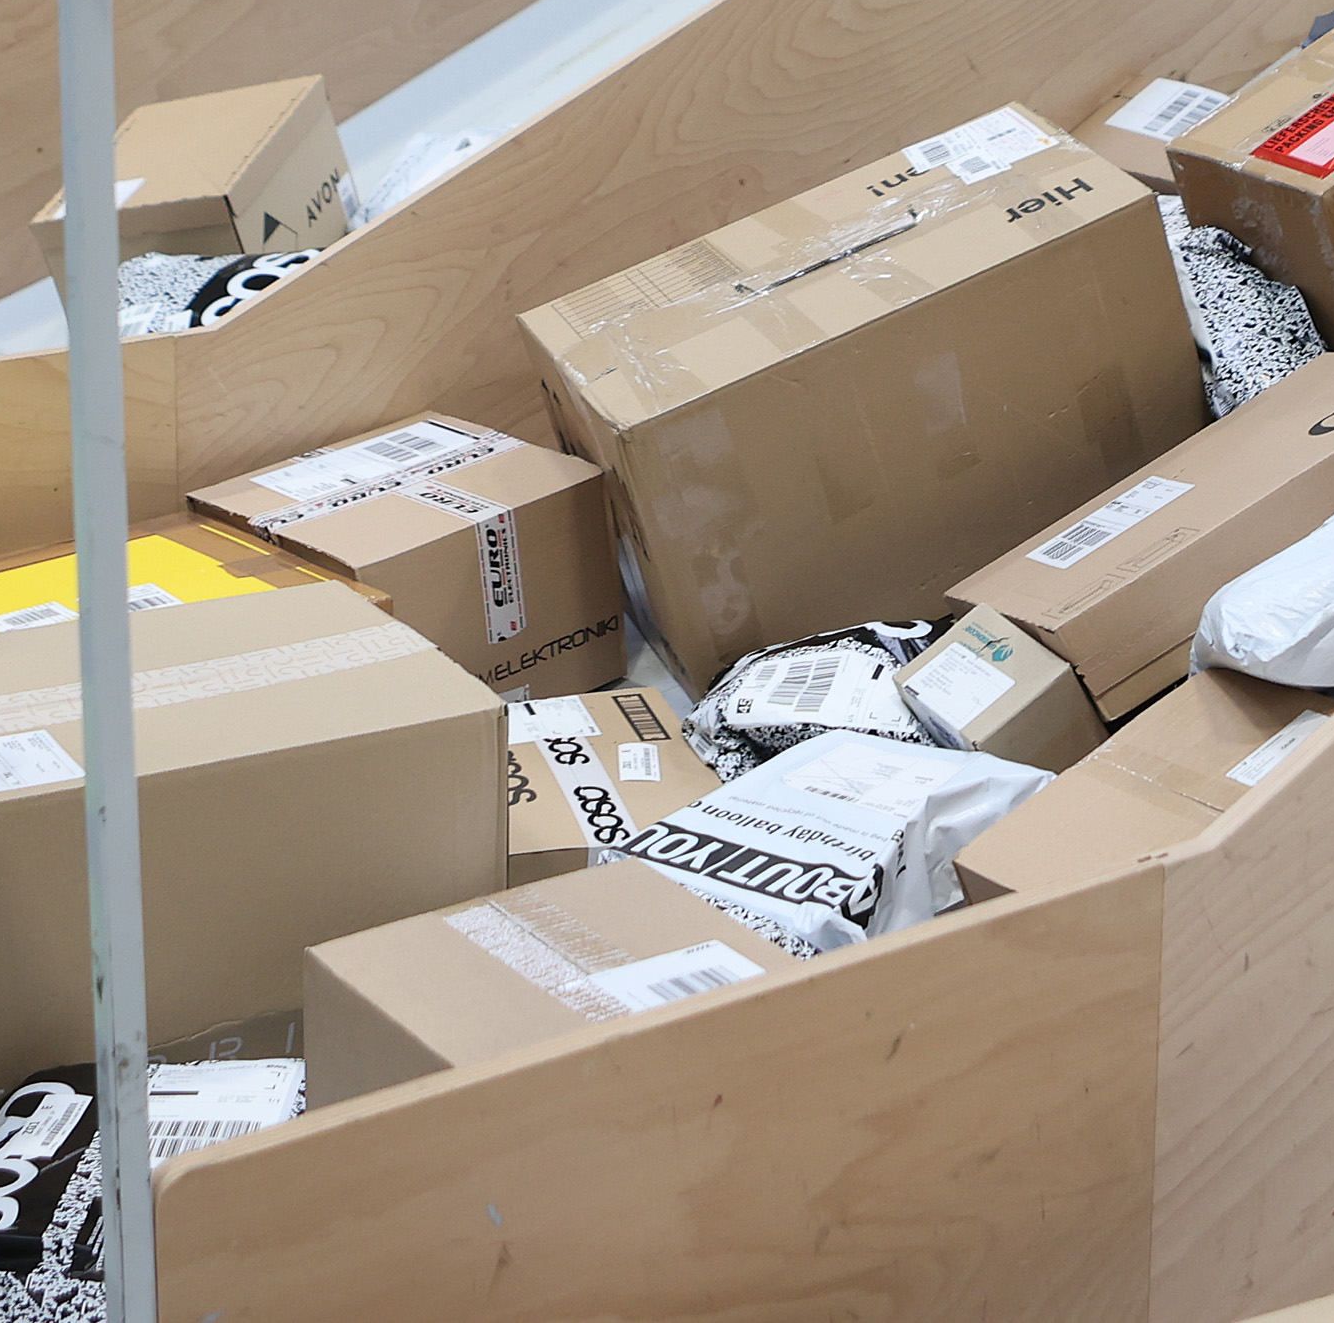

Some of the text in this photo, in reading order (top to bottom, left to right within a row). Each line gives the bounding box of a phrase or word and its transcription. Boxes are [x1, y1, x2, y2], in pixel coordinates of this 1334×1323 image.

[1275, 118, 1324, 153] PACKING
[304, 167, 342, 228] AVON
[1005, 177, 1094, 223] Hier
[331, 480, 402, 509] EURO
[419, 492, 480, 514] EURO
[485, 528, 505, 608] EURO
[502, 528, 514, 604] ELECTRONICS
[701, 802, 778, 842] balloon
